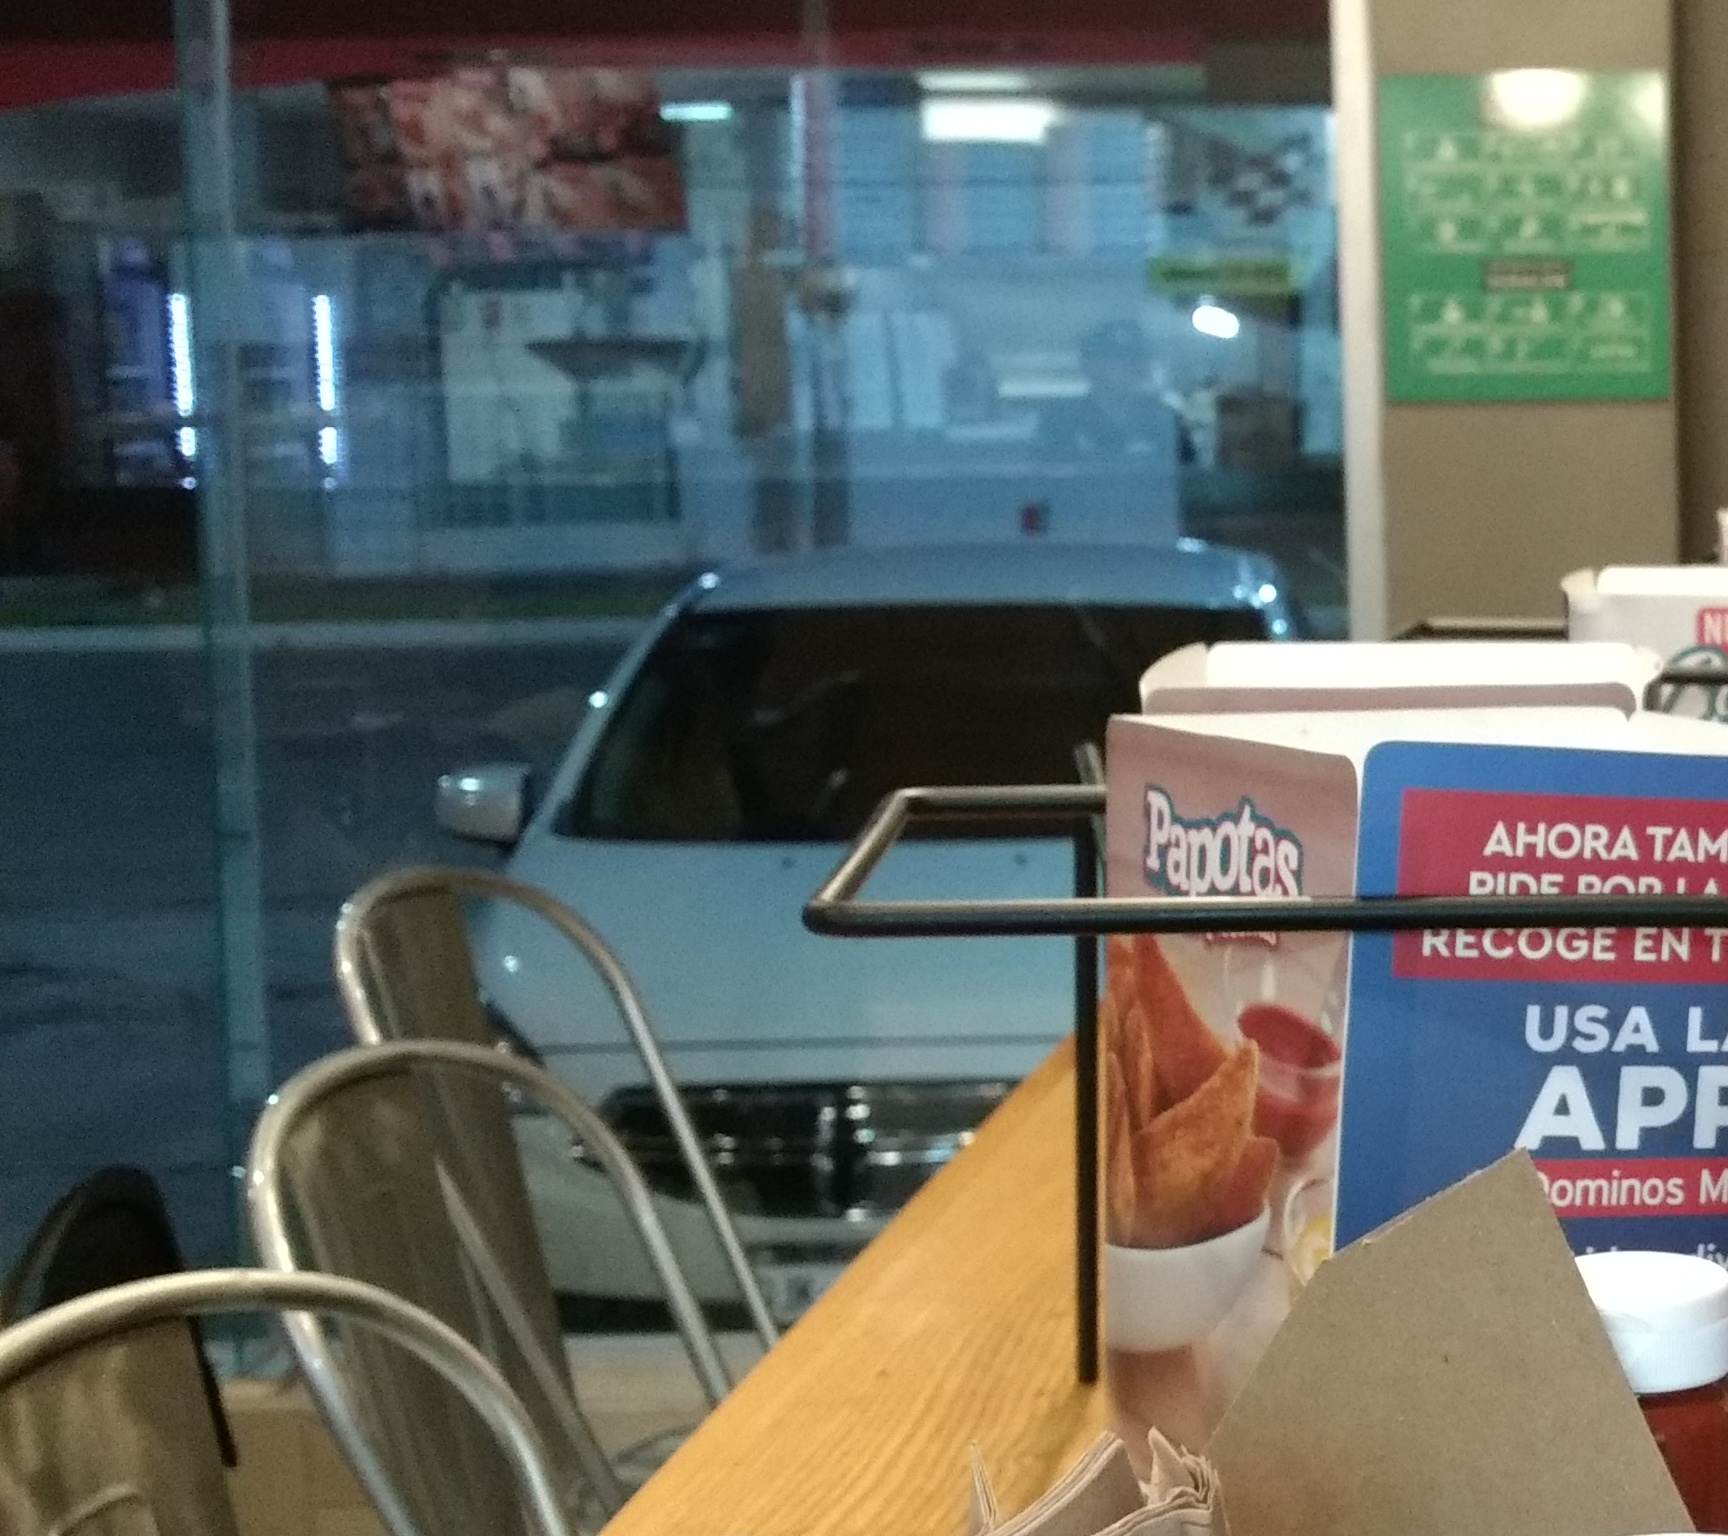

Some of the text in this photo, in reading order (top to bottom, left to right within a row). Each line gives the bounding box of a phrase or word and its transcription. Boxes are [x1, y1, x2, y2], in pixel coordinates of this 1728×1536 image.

[1145, 789, 1300, 899] Papotas
[1483, 822, 1638, 862] AHORA
[1421, 926, 1616, 961] RECOGE
[1633, 927, 1691, 963] EN
[1524, 1004, 1661, 1053] USA
